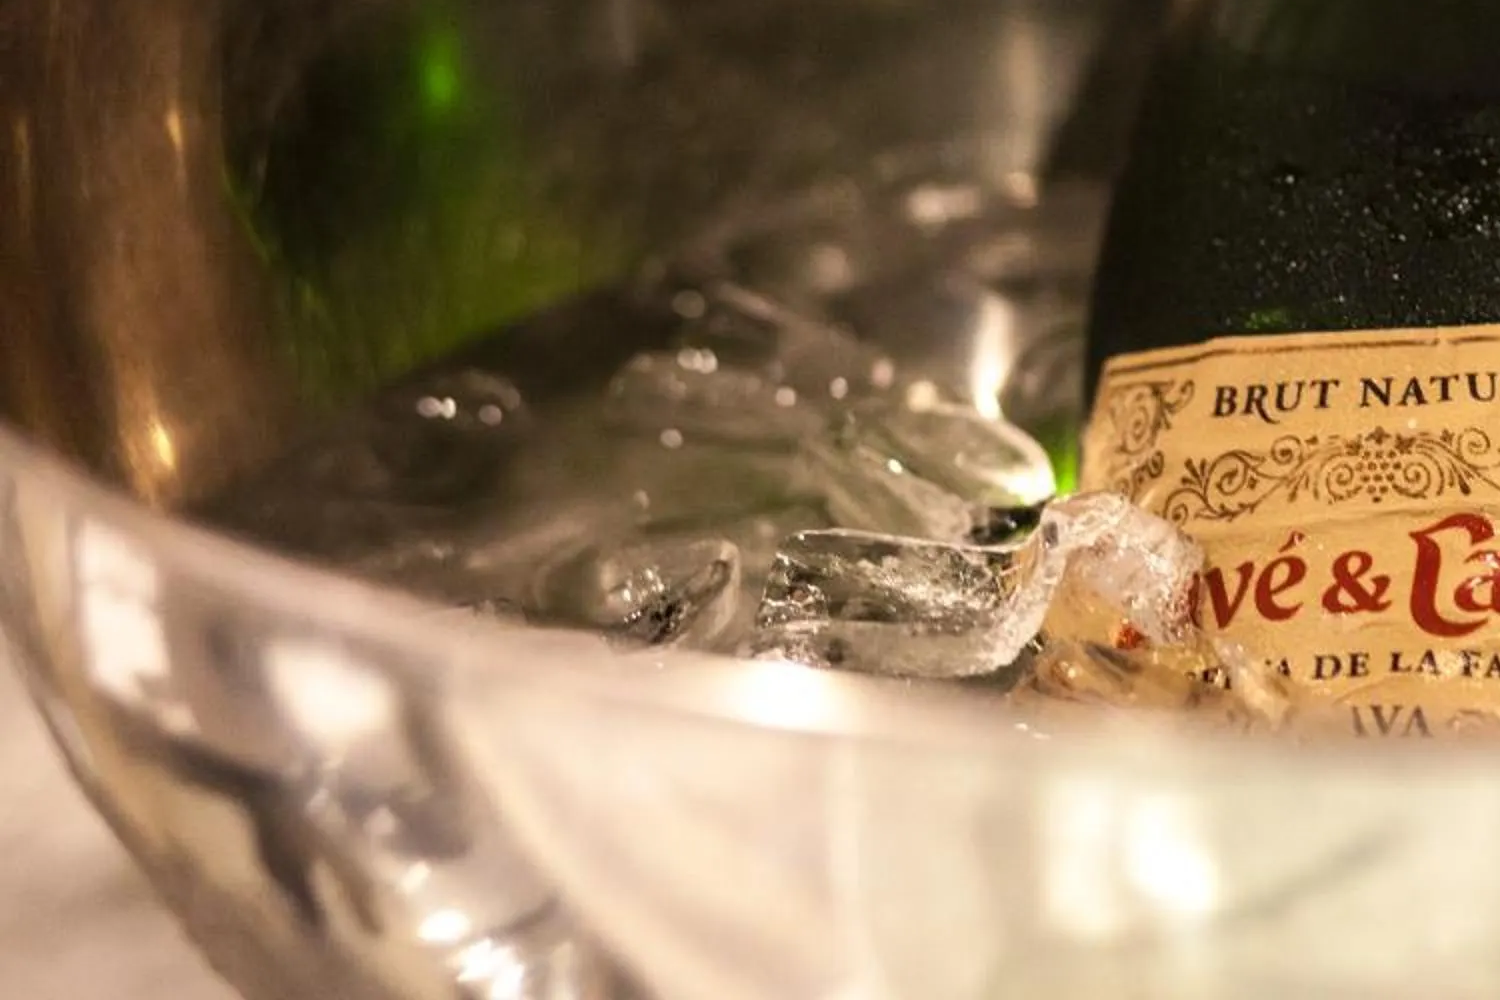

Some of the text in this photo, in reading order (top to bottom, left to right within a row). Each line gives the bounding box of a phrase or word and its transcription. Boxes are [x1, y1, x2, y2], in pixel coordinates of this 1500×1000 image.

[1212, 379, 1340, 424] BRUT
[1321, 550, 1393, 614] &
[1312, 652, 1370, 682] DE
[1390, 648, 1440, 675] LA
